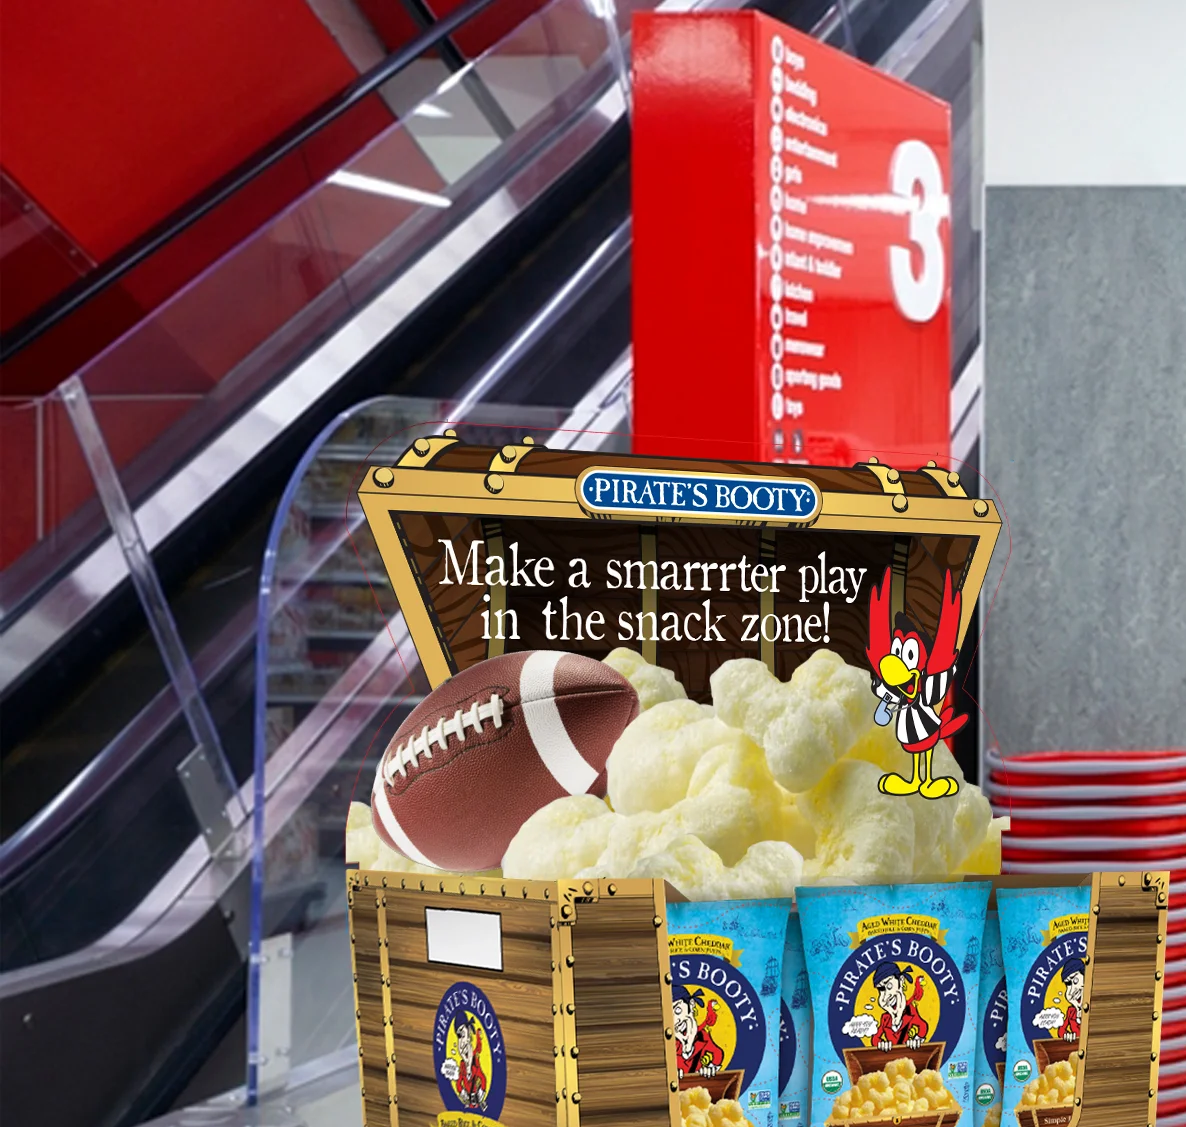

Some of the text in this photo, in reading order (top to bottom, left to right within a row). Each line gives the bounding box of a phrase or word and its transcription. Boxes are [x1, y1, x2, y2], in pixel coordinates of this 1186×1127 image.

[889, 139, 944, 322] 3
[594, 474, 808, 513] PIRATE'S BOOTY
[437, 538, 868, 605] Make a smarrrter play
[481, 593, 831, 644] in the snack zone!
[697, 962, 757, 1023] BOOTY
[835, 939, 959, 1005] PIRATE'S BOOTY
[1028, 937, 1087, 998] PIRATE'S
[436, 989, 502, 1056] PIRATE'S BOOTY
